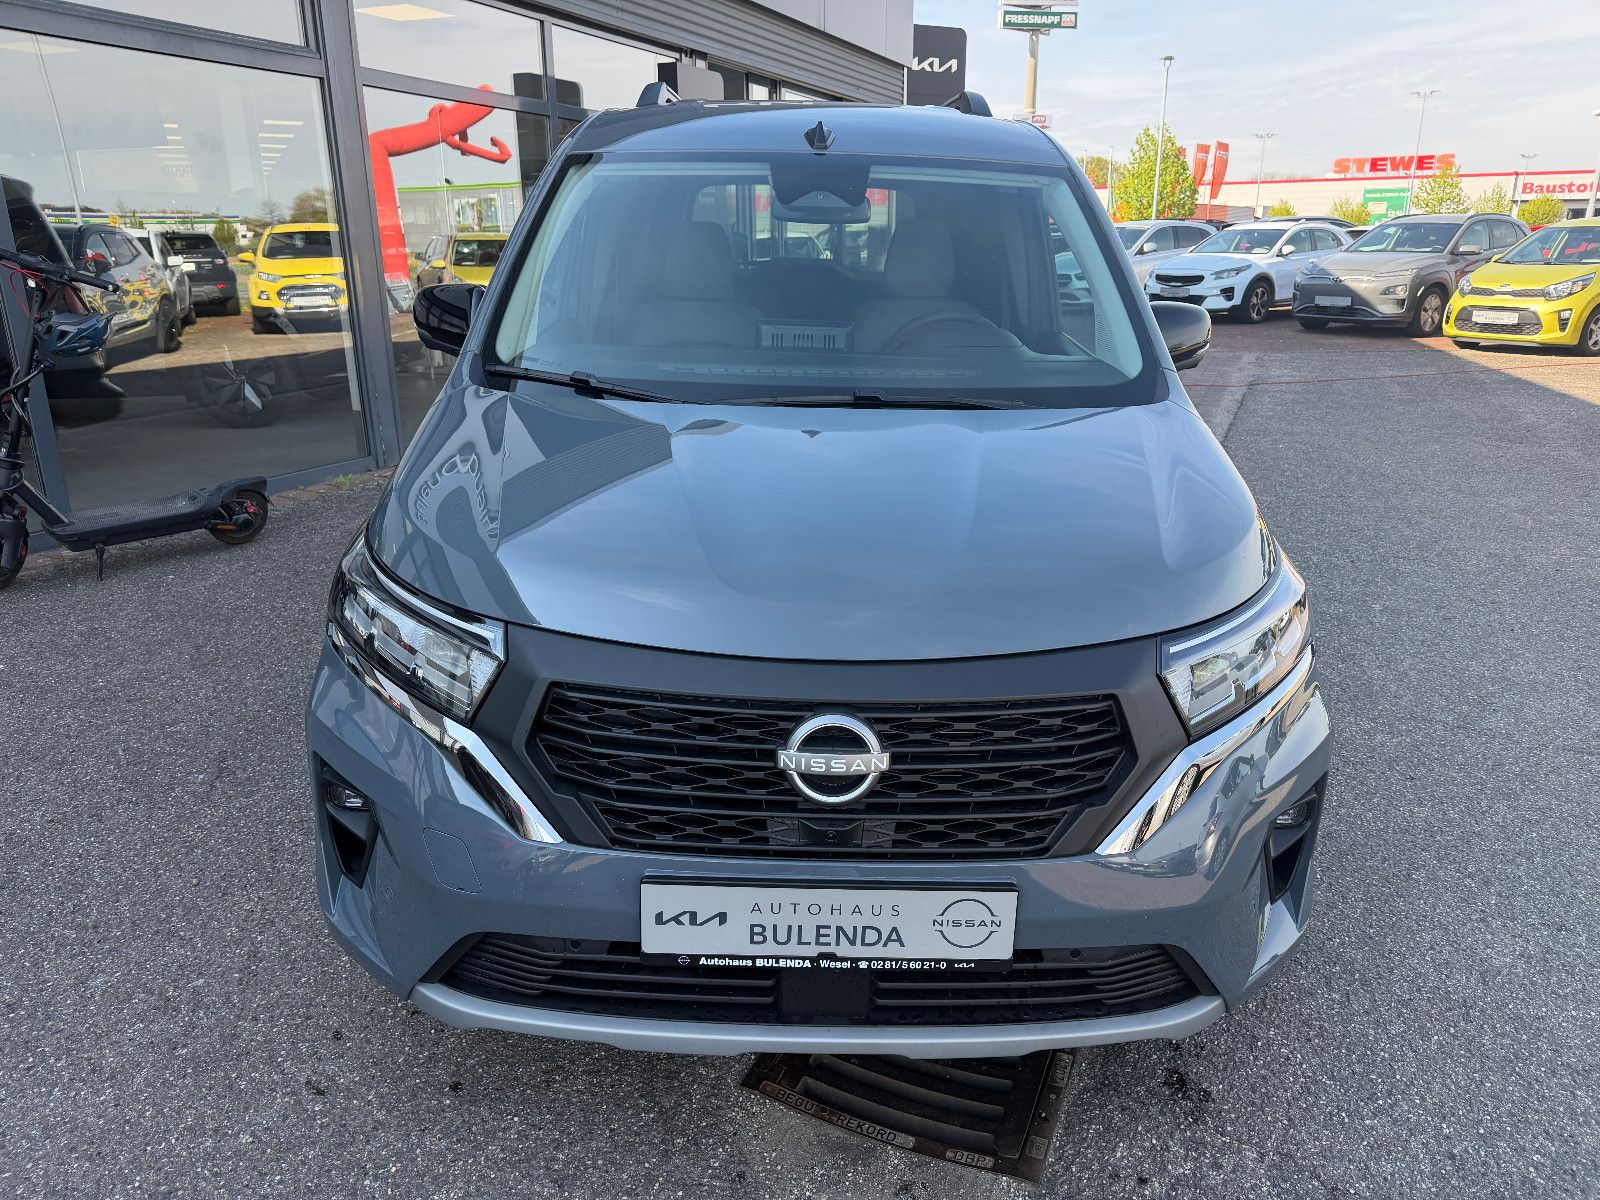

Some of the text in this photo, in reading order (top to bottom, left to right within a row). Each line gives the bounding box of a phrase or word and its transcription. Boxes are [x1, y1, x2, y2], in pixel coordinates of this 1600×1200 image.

[1005, 14, 1061, 25] FRESSNAPF
[911, 56, 958, 74] KIA
[1333, 153, 1456, 174] STEWES
[779, 754, 888, 772] NISSAN
[654, 910, 728, 927] KIA
[749, 902, 901, 918] AUTOHAUS
[932, 918, 1002, 929] NISSAN
[749, 923, 906, 948] BULENDA
[699, 956, 753, 967] Autohaus
[755, 958, 811, 968] BULENDA
[819, 959, 851, 969] Wesel
[777, 1088, 815, 1112] BEGU
[835, 1112, 898, 1143] REKORD
